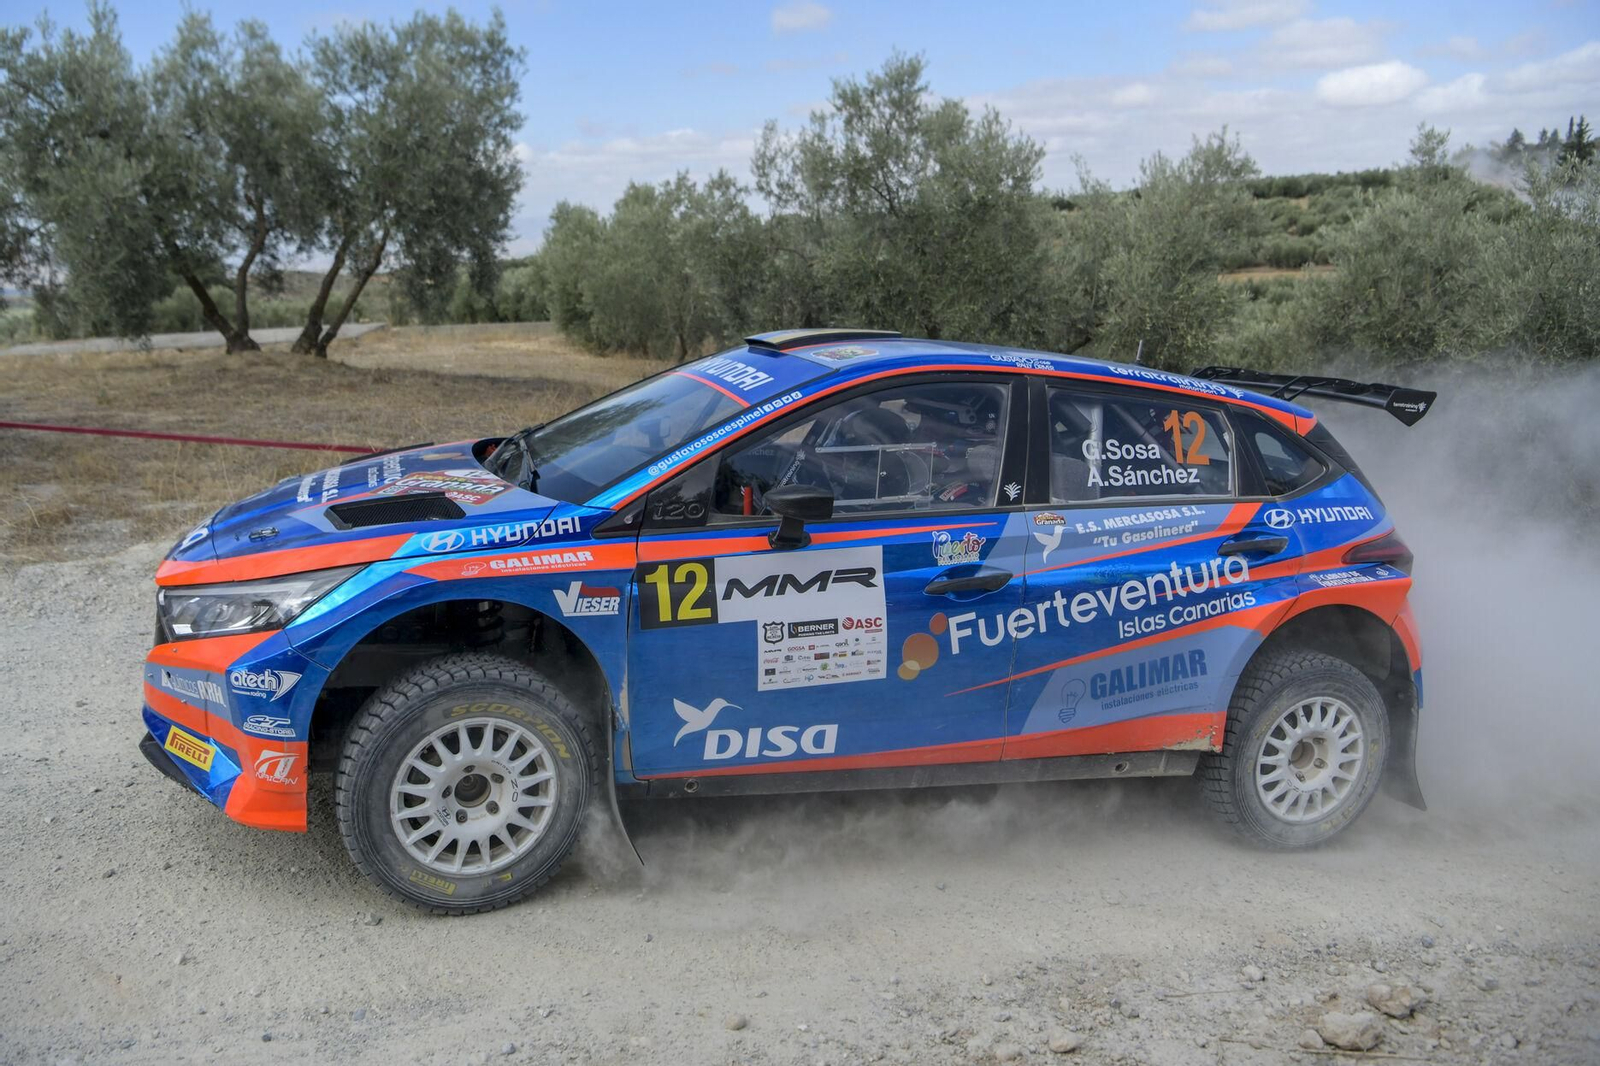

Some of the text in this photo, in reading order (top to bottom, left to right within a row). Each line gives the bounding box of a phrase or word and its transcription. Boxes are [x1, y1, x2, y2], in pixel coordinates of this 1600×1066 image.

[1107, 365, 1226, 395] terratraining
[648, 406, 765, 476] @gustavososaespinel
[1081, 439, 1161, 460] G.Sosa
[1163, 410, 1210, 465] 12
[1087, 464, 1200, 487] A.Sánchez
[1075, 505, 1206, 534] E.S. MERCASOSA S.L.
[1297, 506, 1374, 524] HYUNDAI
[471, 516, 581, 546] HYUNDAI
[932, 530, 986, 559] Puerto
[490, 551, 594, 569] GALIMAR
[553, 581, 621, 616] VIESER
[645, 562, 878, 622] 12 MMR
[948, 556, 1250, 655] Fuerteventura
[798, 617, 883, 633] BERNER ASC
[1118, 591, 1256, 639] Islas Canarias
[230, 669, 279, 691] atech
[1090, 649, 1208, 700] GALIMAR
[1101, 681, 1199, 710] instalaciones eléctricas
[451, 703, 571, 759] SCORPION
[169, 731, 210, 765] PIRELLI
[408, 869, 457, 896] PIRELLI
